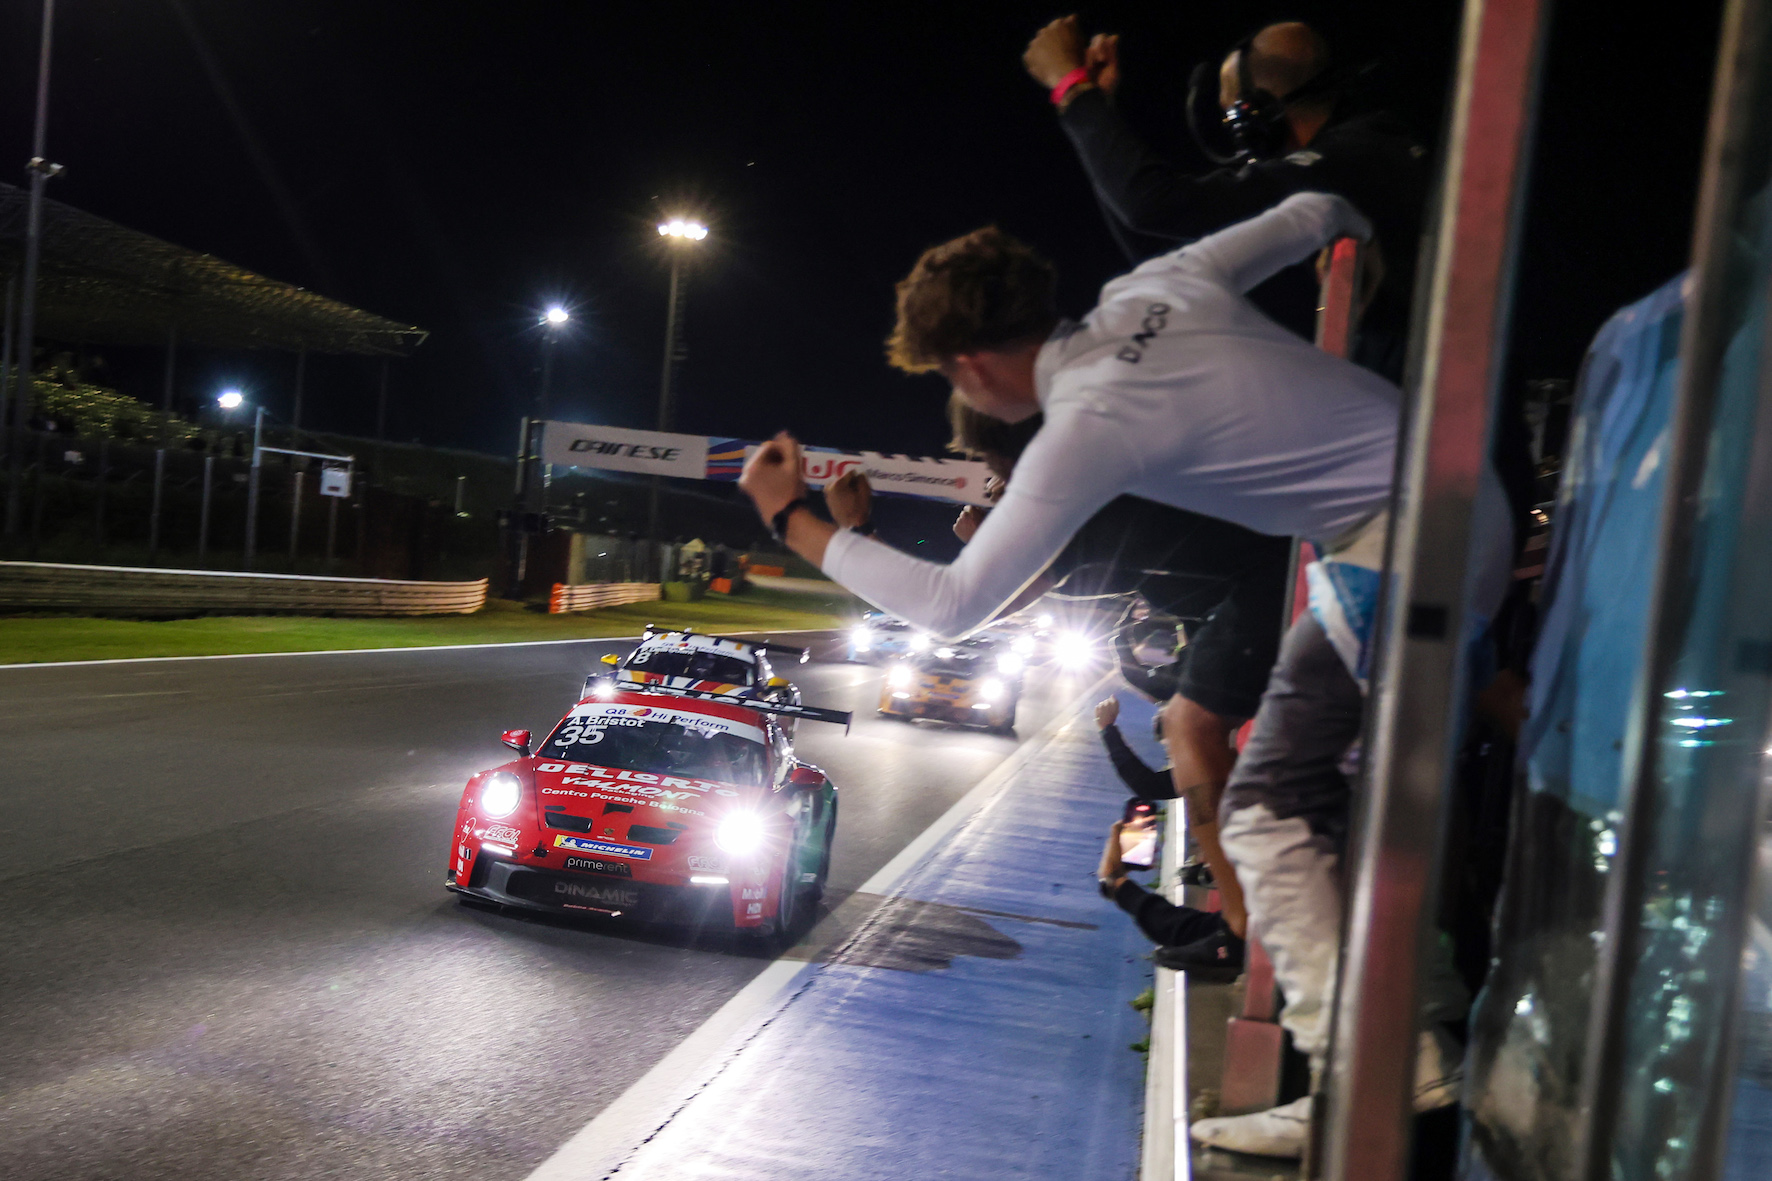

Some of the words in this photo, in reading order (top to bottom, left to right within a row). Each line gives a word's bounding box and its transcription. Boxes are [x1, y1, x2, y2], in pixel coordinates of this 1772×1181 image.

[568, 439, 683, 462] DAINESE
[633, 651, 652, 665] 8
[586, 716, 646, 728] Bristot
[605, 708, 627, 716] Q8
[651, 712, 668, 720] Hi
[675, 715, 729, 731] Perform
[554, 725, 609, 747] 35
[541, 788, 588, 798] Centro
[590, 792, 646, 806] Porsche
[649, 801, 706, 817] Bologna
[580, 842, 645, 856] MICHELIN
[567, 858, 628, 873] primerent
[554, 881, 638, 904] DINAMIC
